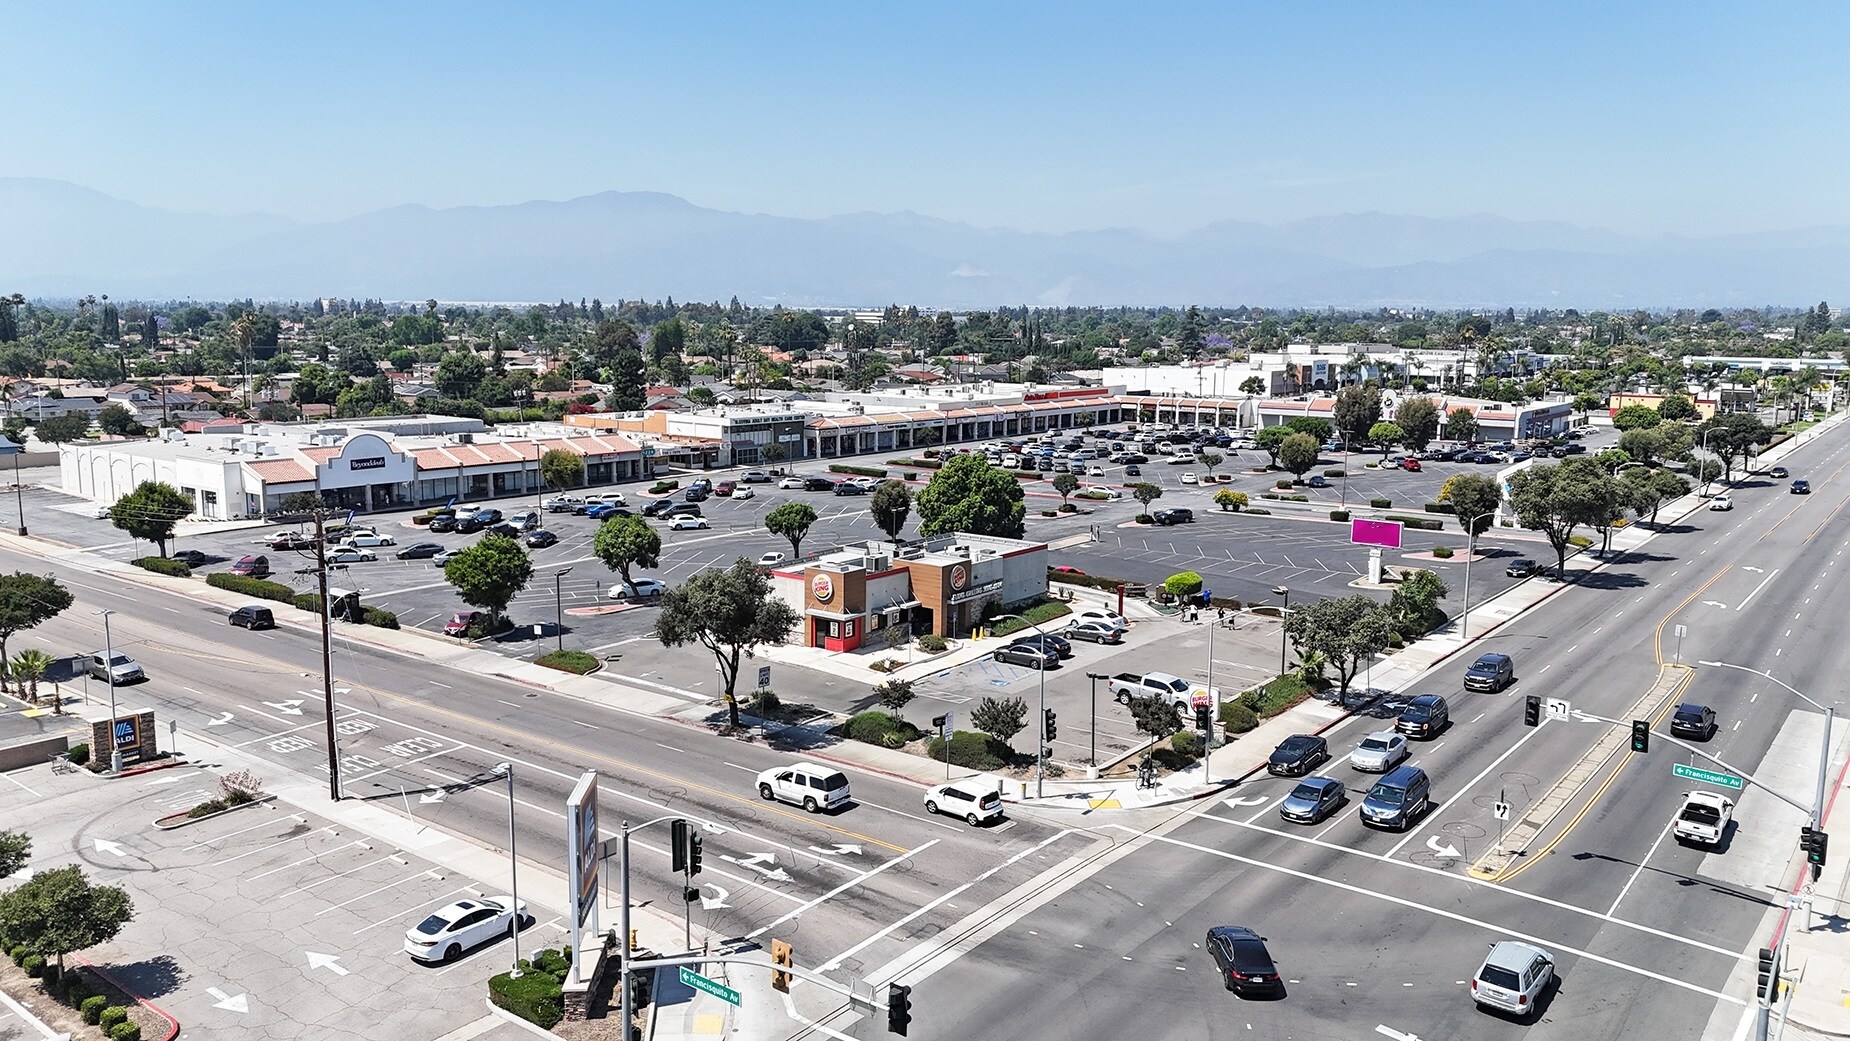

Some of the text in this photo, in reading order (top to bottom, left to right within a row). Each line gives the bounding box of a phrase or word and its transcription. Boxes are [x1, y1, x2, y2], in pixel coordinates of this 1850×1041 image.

[759, 676, 770, 685] 40
[336, 718, 380, 735] KEEP
[116, 734, 135, 744] ALDI
[266, 735, 318, 753] KEEP
[379, 736, 444, 757] CLEAR
[1685, 769, 1740, 786] Francisquito Av
[690, 975, 739, 1003] Francisquito Av
